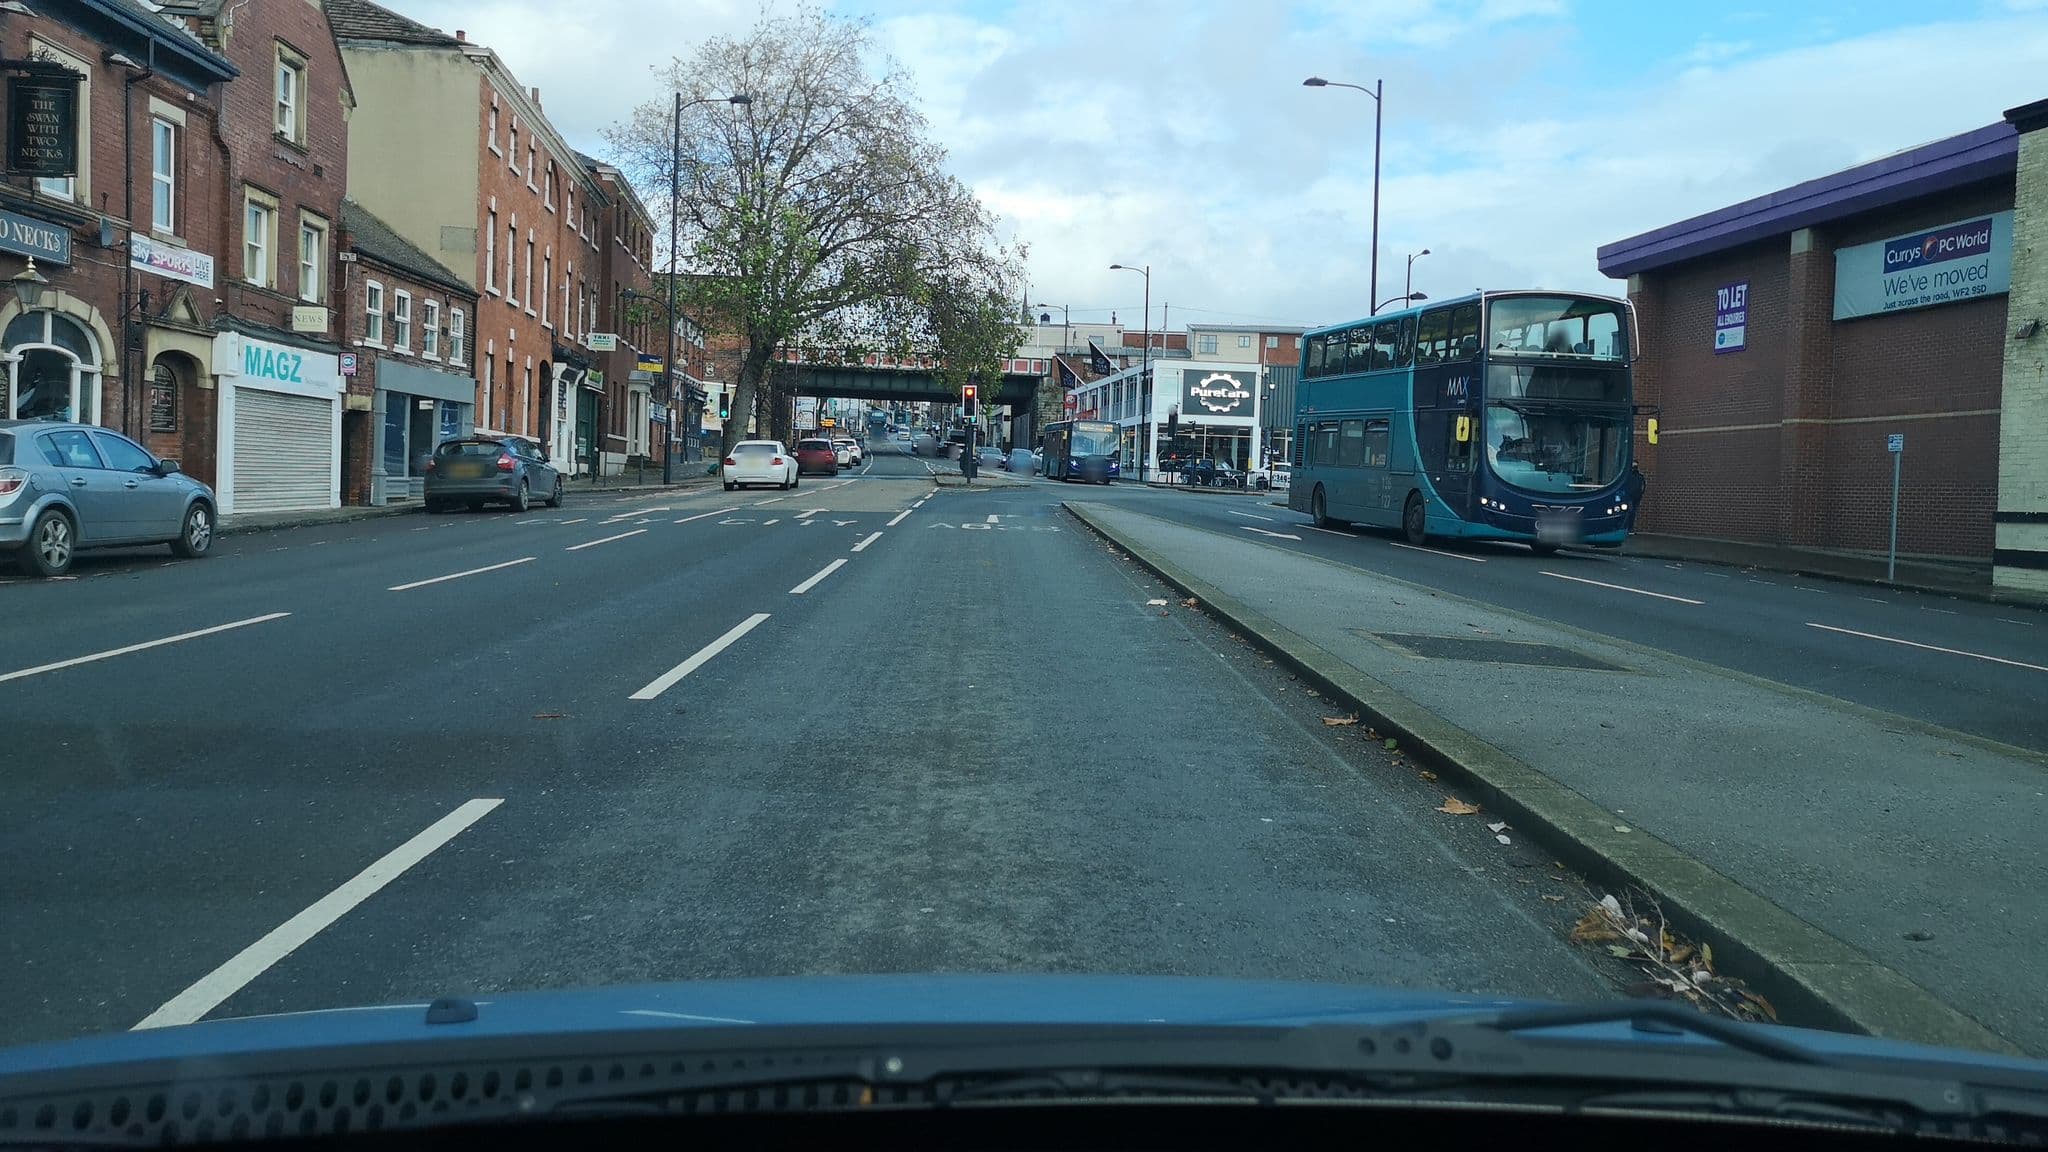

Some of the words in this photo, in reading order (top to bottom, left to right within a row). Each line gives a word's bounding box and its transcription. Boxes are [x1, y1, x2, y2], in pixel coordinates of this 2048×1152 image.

[32, 99, 55, 110] THE
[26, 112, 59, 123] SWAN
[27, 124, 60, 134] WITH
[27, 136, 58, 147] TWO
[21, 147, 64, 159] NECKS
[12, 222, 61, 252] NECKS
[1886, 246, 1922, 265] Currys
[1938, 237, 1955, 254] PC
[1956, 229, 1989, 250] World
[131, 242, 150, 263] sky
[150, 251, 192, 274] SPORTS
[194, 257, 210, 273] LIVE
[1883, 274, 1929, 298] We've
[1933, 258, 1989, 289] moved
[1717, 287, 1729, 311] TO
[1730, 284, 1747, 309] LET
[1883, 302, 1897, 311] Just
[1898, 297, 1919, 308] across
[1920, 294, 1931, 303] the
[1952, 286, 1970, 298] WF2
[294, 314, 324, 323] NEWS
[244, 345, 303, 383] MAGZ
[1190, 386, 1250, 399] PureCars
[1446, 375, 1470, 399] MAX
